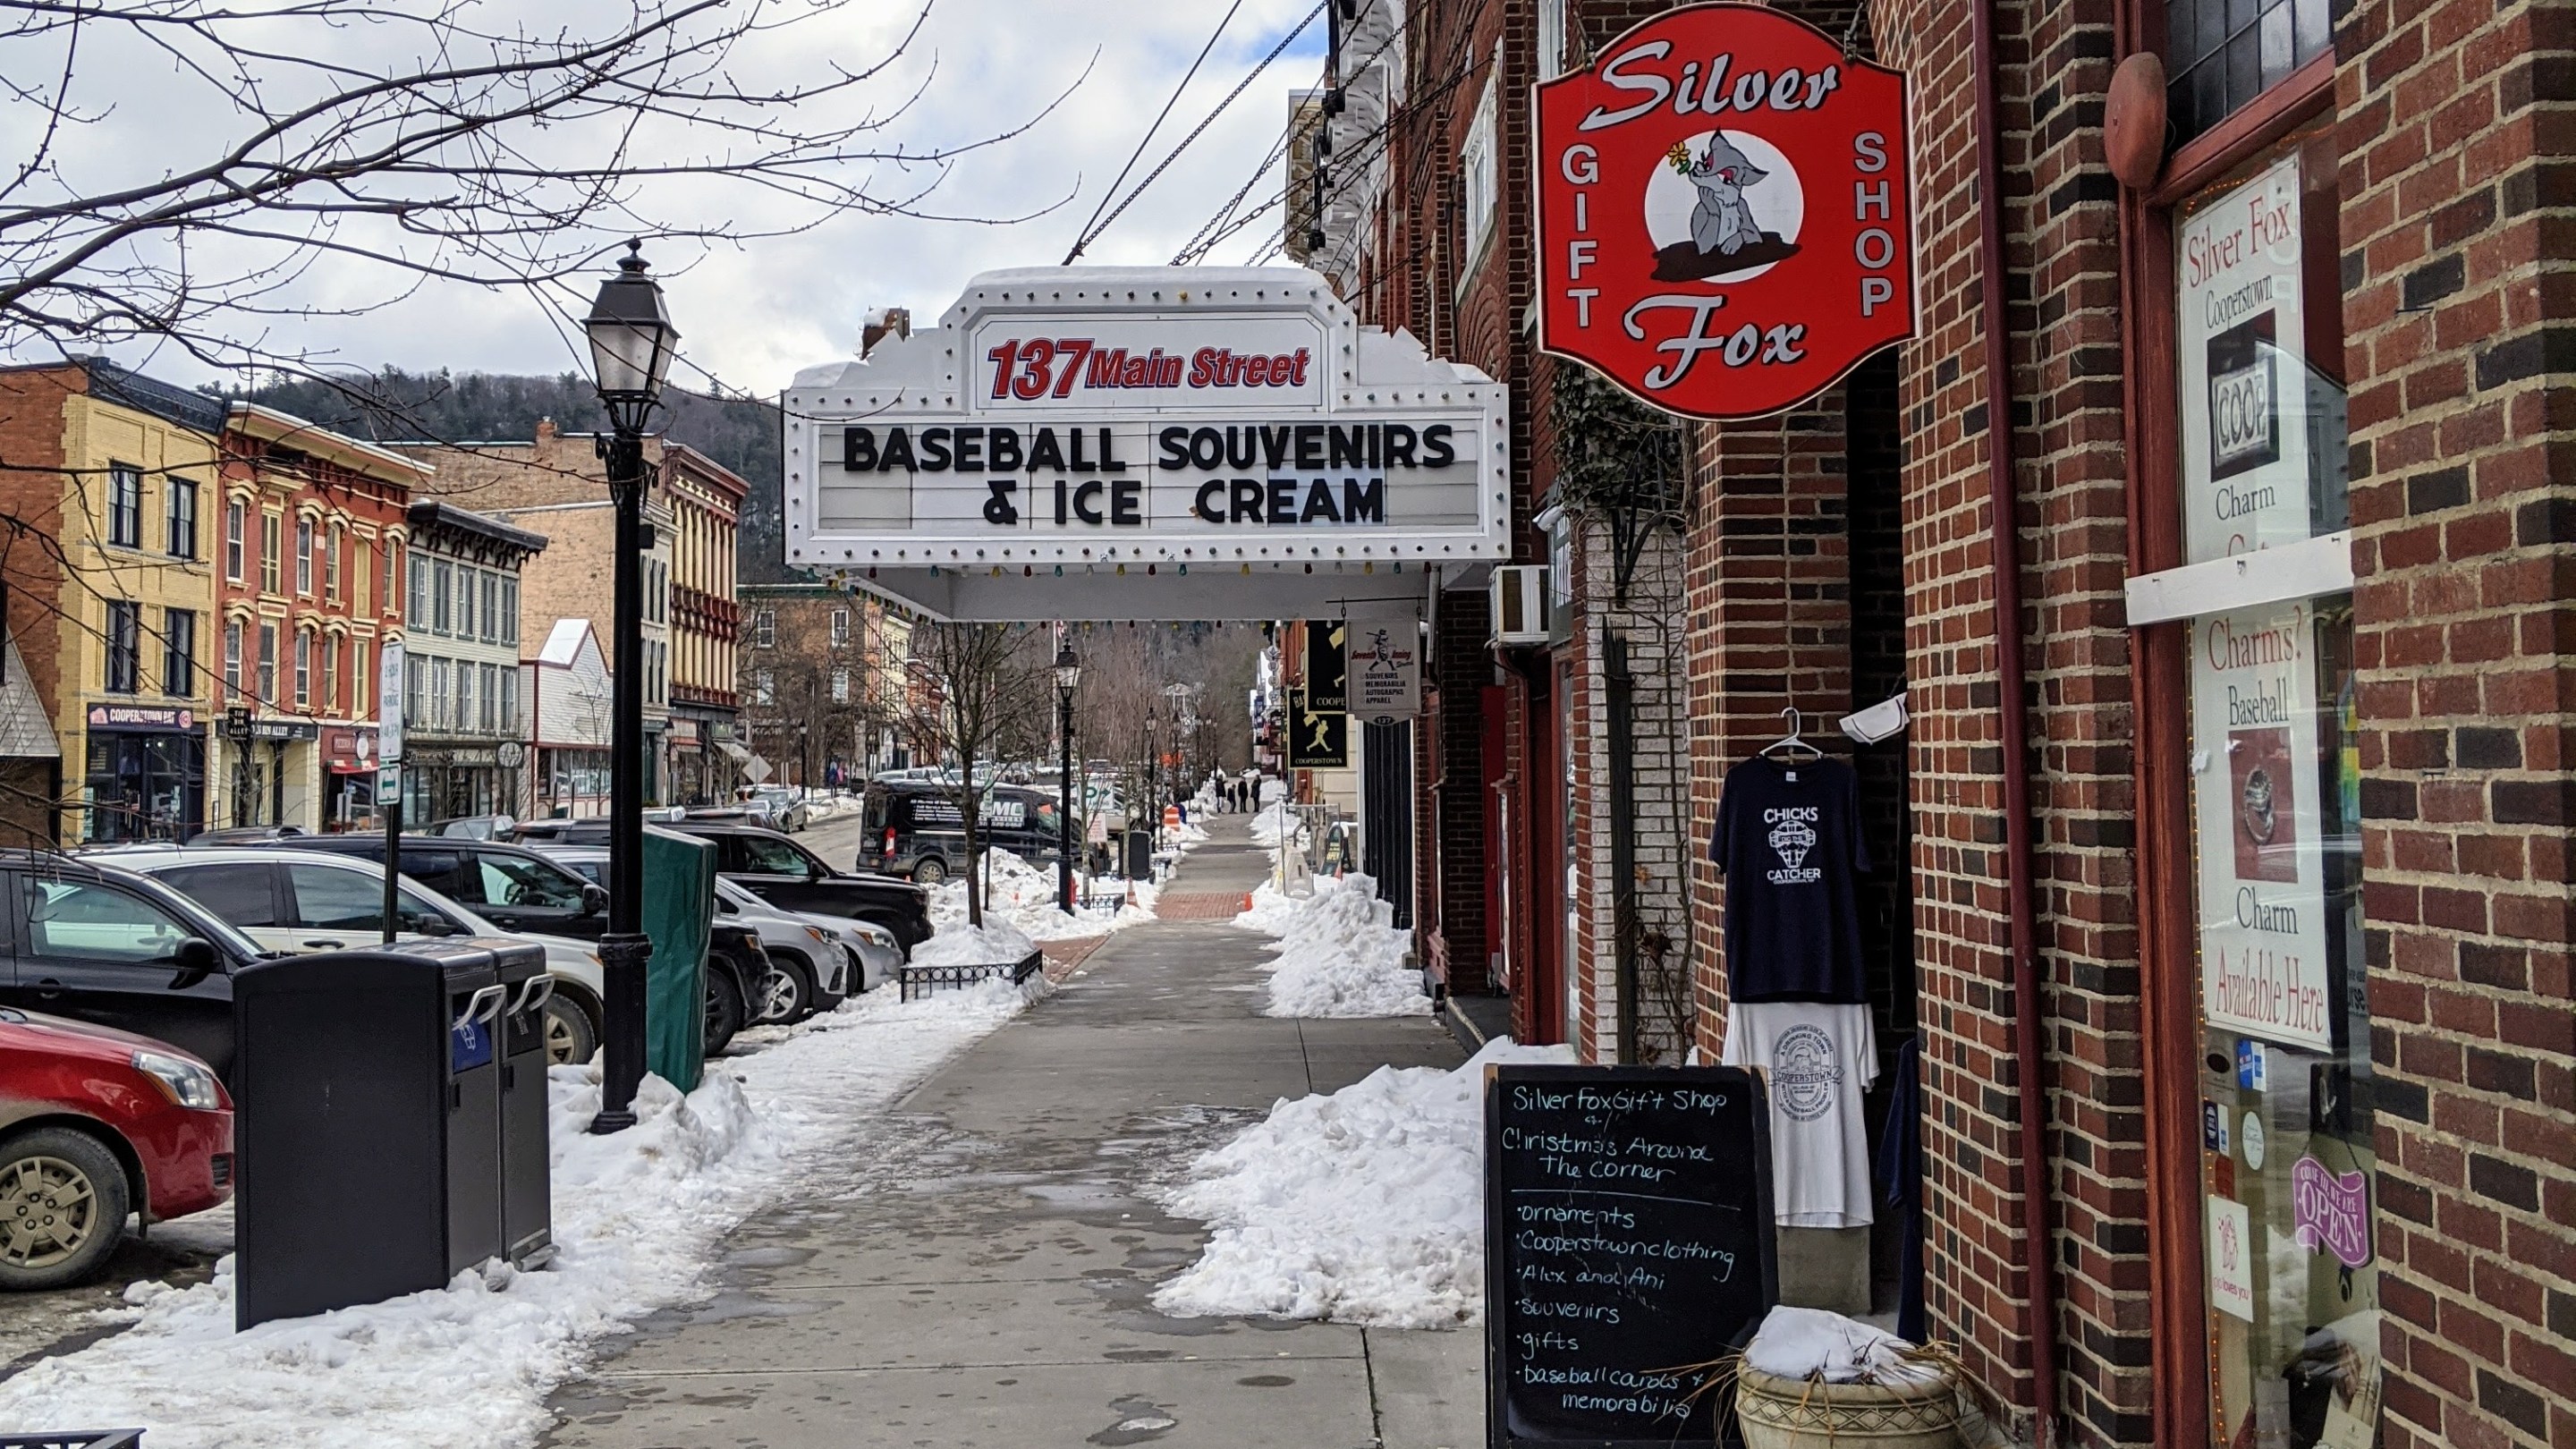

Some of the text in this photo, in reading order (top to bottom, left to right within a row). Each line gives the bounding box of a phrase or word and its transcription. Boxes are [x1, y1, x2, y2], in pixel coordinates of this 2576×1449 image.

[1579, 40, 1840, 131] Silver
[1561, 144, 1600, 328] GIFT
[1853, 131, 1895, 318] SHOP
[2187, 224, 2242, 289] Silver
[2249, 195, 2292, 257] Fox
[2206, 273, 2274, 330] Cooperstown
[1623, 293, 1808, 390] Fox
[987, 337, 1310, 401] 137 Main Street
[2217, 373, 2267, 446] COOP
[843, 423, 1455, 472] BASEBALL SOUVENIRS
[982, 478, 1385, 525] & ICE CREAM
[2216, 483, 2276, 521] Charm
[2207, 605, 2302, 673] Charms?
[2227, 676, 2290, 725] Baseball
[1764, 807, 1818, 824] CHICKS
[1767, 869, 1821, 881] CATCHER
[2236, 886, 2300, 936] Charm
[2215, 945, 2324, 1033] Available Here
[1783, 1033, 1811, 1050] DRINKING
[1813, 1036, 1827, 1055] TOWN
[1776, 1069, 1833, 1082] COOPERSTOWN
[1513, 1086, 1573, 1111] Silver
[1577, 1087, 1611, 1110] Fox
[1673, 1089, 1727, 1115] Shop
[1538, 1154, 1582, 1178] The
[1626, 1137, 1714, 1161] Around
[2301, 1181, 2359, 1252] OPEN
[1576, 1272, 1621, 1285] and
[1628, 1267, 1665, 1290] Ani
[1521, 1333, 1579, 1360] gifts
[1563, 1394, 1690, 1419] memorabilia
